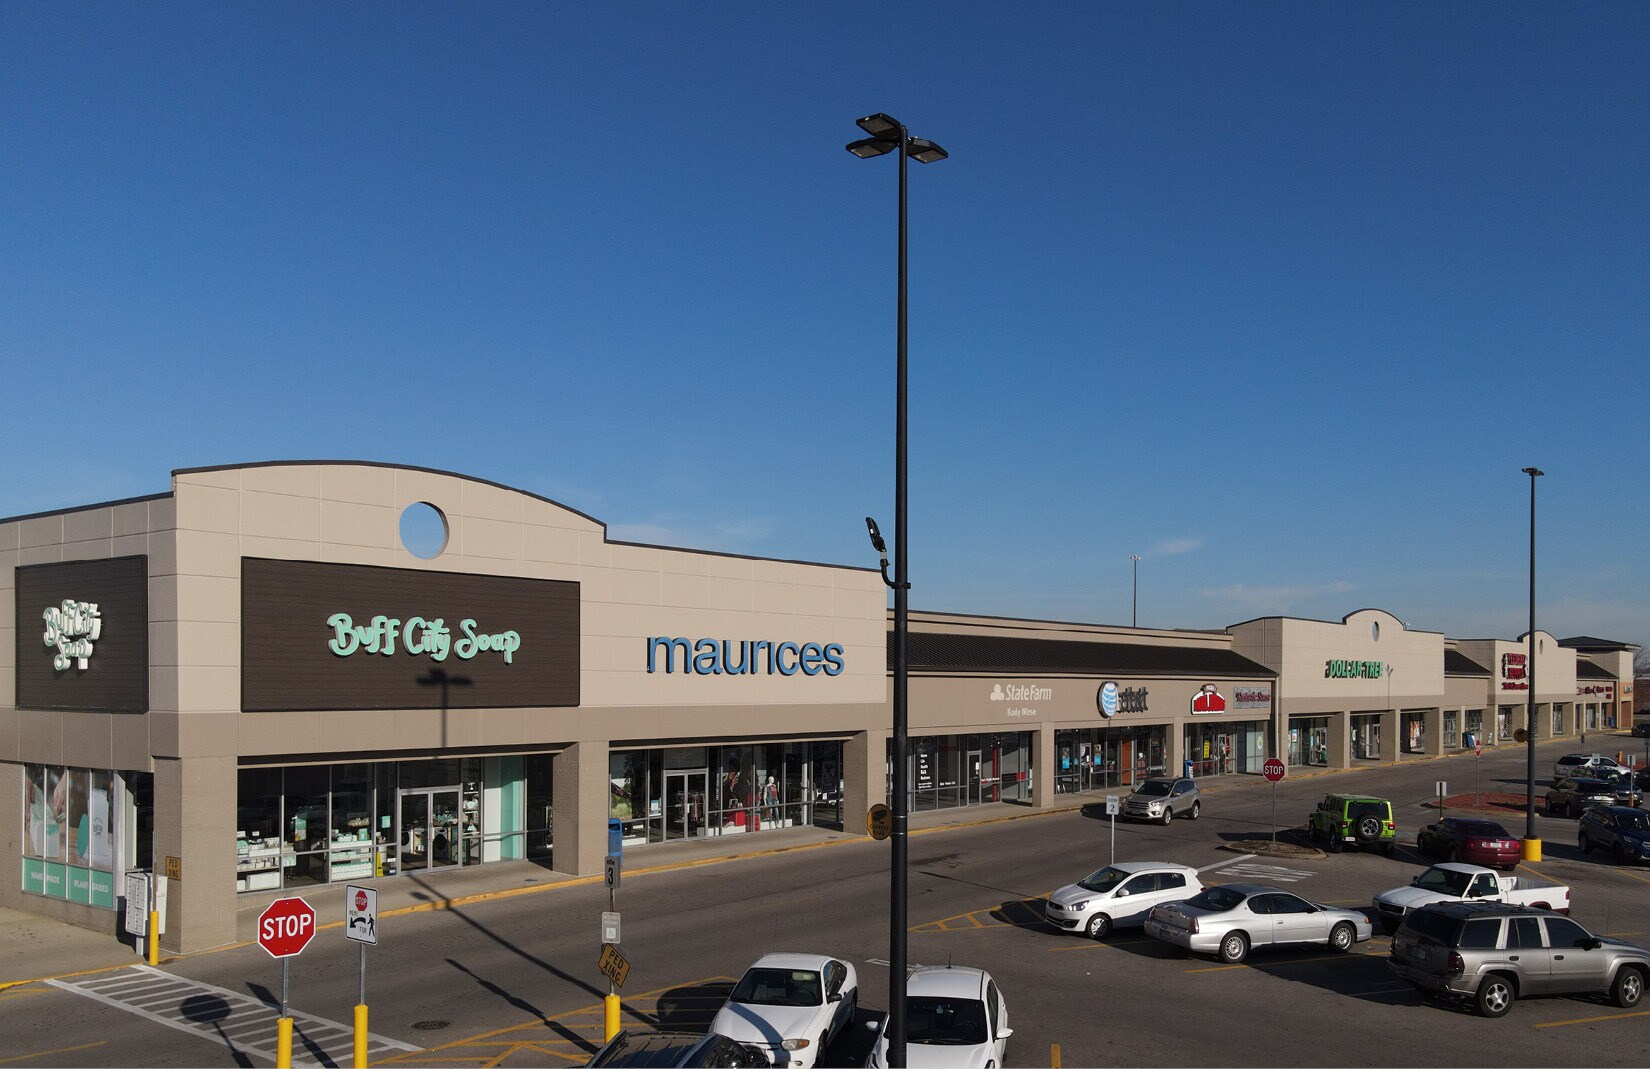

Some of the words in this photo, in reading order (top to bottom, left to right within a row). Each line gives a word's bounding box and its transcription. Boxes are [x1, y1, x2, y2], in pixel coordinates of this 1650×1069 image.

[327, 613, 401, 656] Buff
[403, 616, 451, 661] City
[454, 618, 521, 664] Soap
[54, 636, 94, 671] Soap
[646, 636, 845, 677] maurices
[1325, 659, 1364, 678] DOLLAR
[1264, 765, 1284, 775] STOP
[1109, 804, 1115, 812] 2
[607, 867, 614, 885] 3
[356, 896, 368, 906] STOP
[262, 913, 312, 940] STOP
[609, 950, 624, 969] PED
[603, 960, 621, 981] XING
